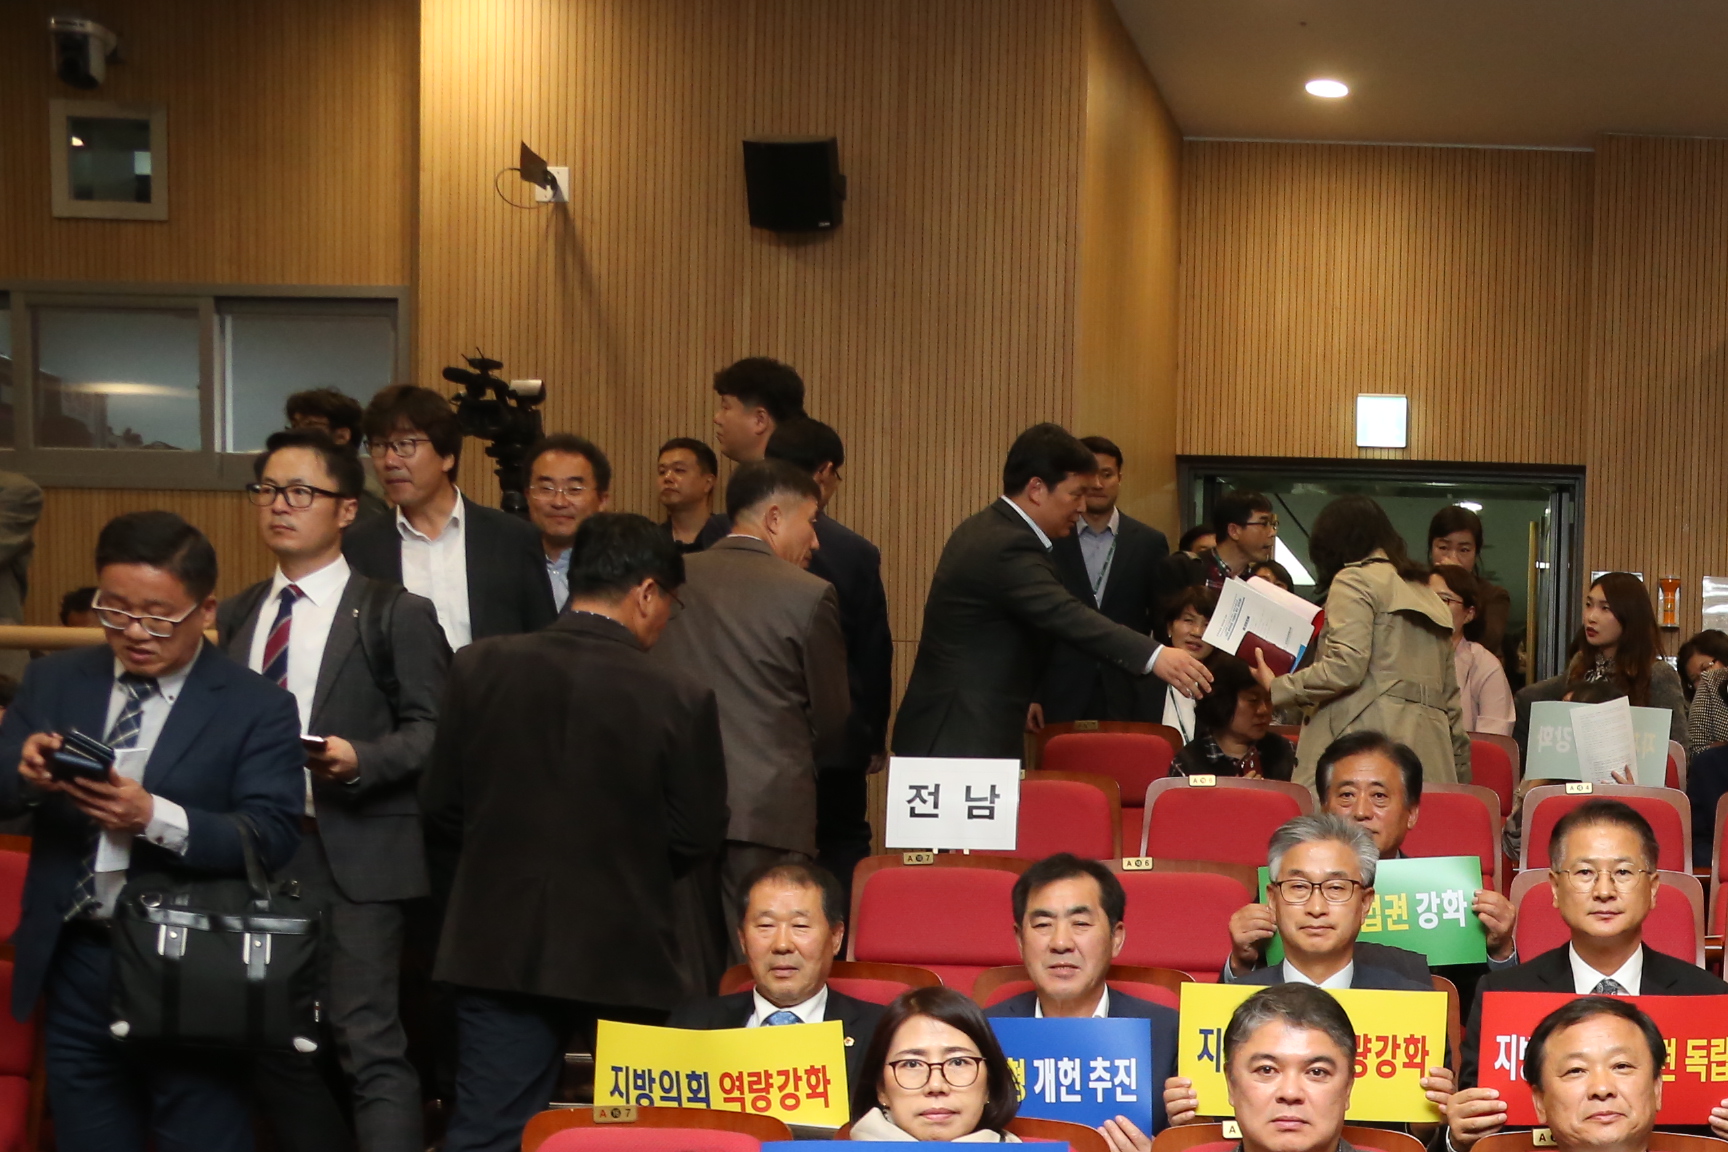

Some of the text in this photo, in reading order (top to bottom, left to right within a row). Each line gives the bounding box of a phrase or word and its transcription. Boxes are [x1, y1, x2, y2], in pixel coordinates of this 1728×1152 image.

[908, 784, 999, 819] 전 남
[1416, 889, 1467, 929] 강화
[610, 1065, 831, 1113] 지방의회 역량강화
[1034, 1058, 1081, 1102] 개헌
[1089, 1057, 1136, 1102] 추진
